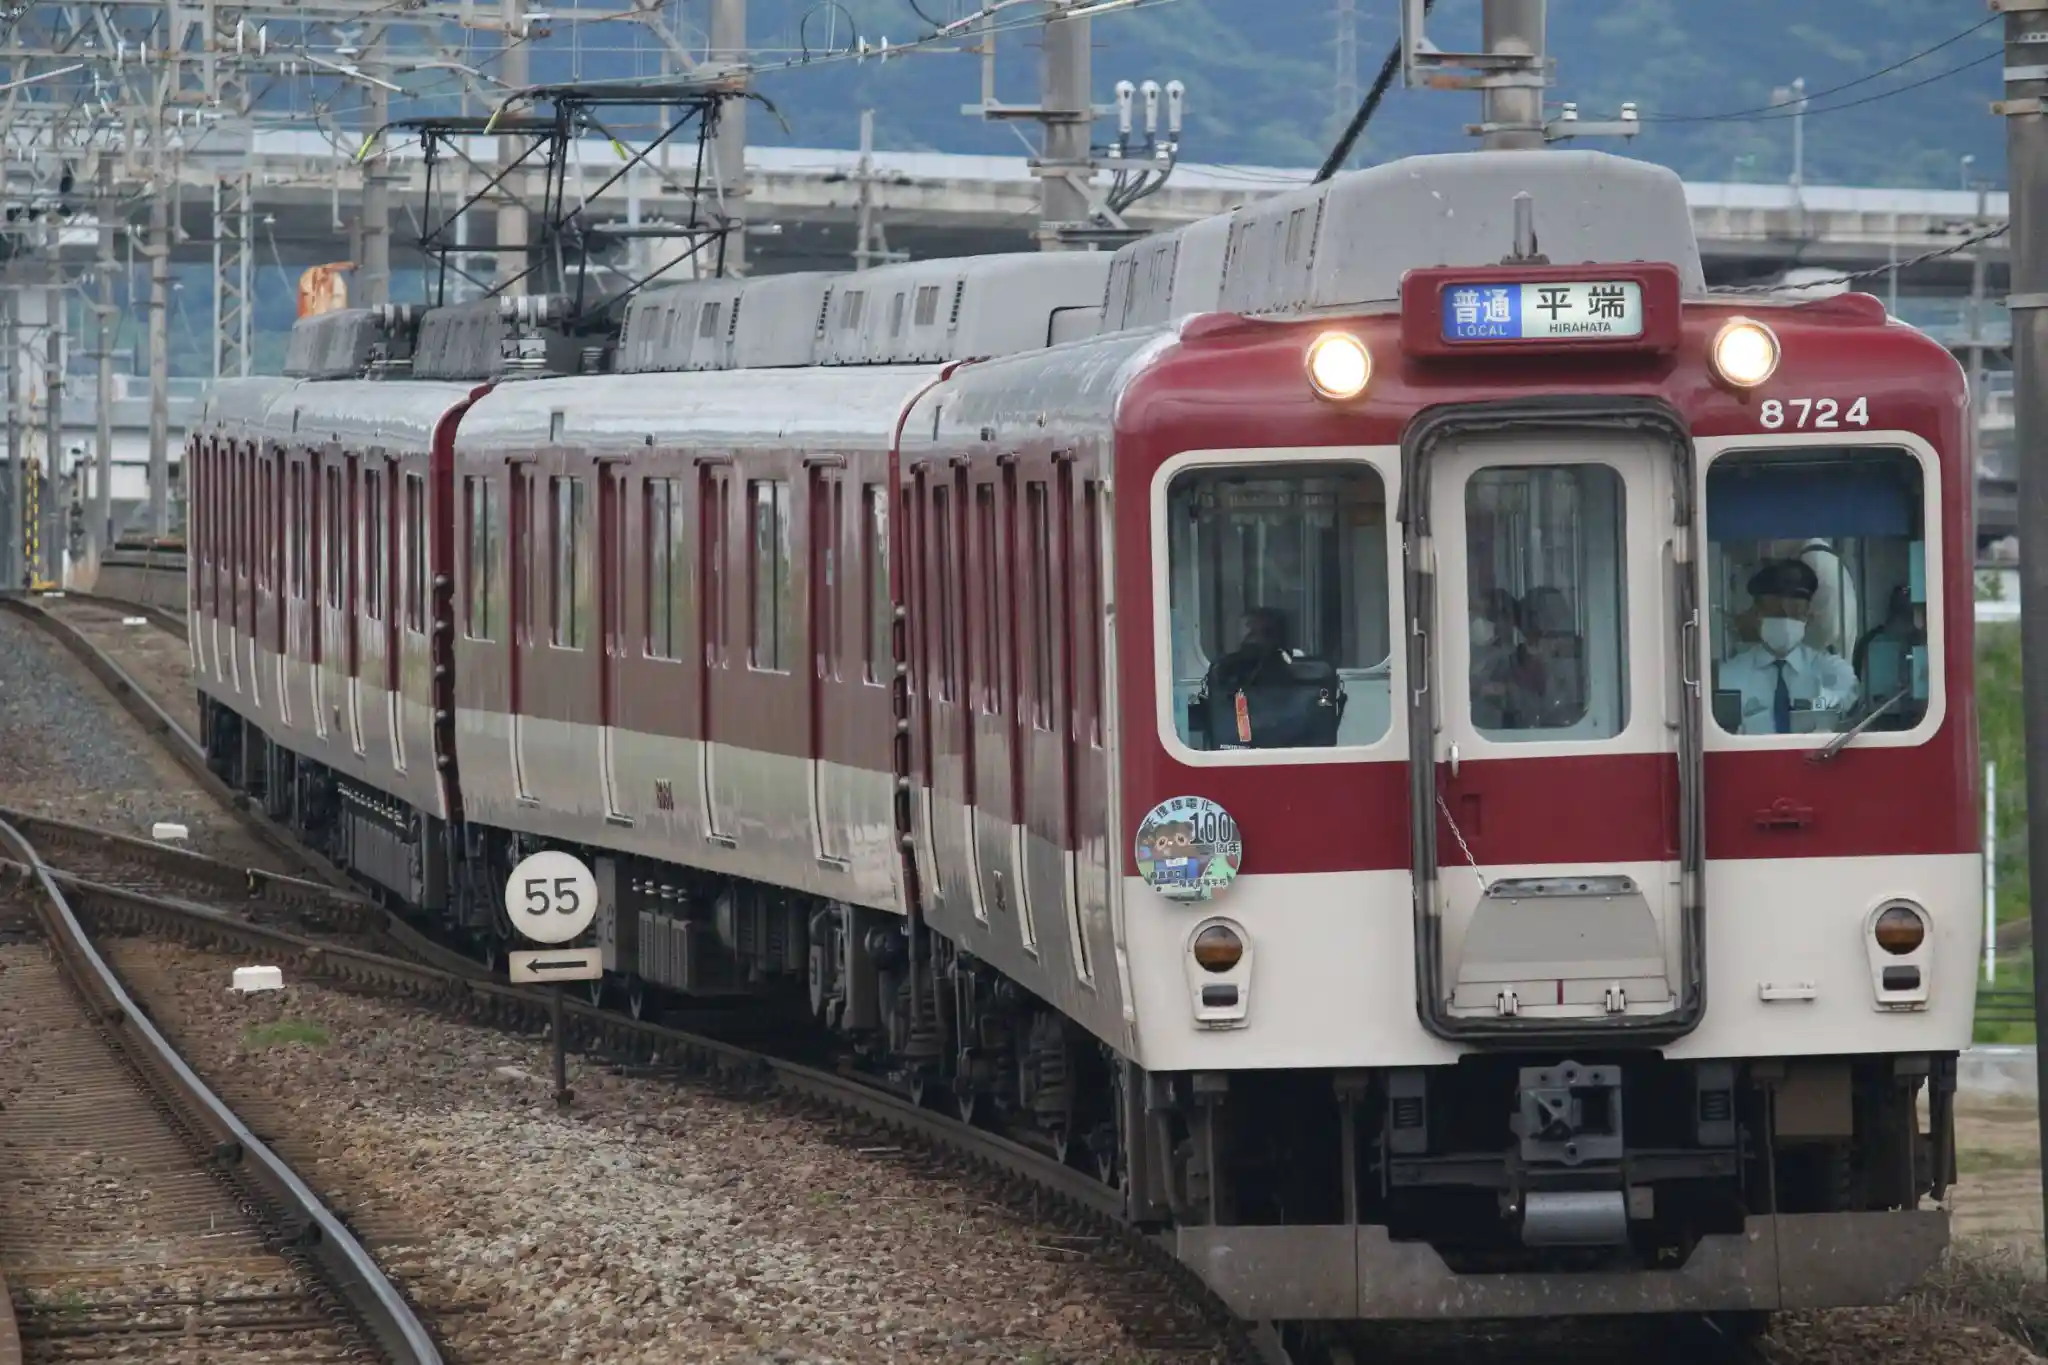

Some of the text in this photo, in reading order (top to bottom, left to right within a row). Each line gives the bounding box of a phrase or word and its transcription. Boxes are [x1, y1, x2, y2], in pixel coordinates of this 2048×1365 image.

[1452, 288, 1511, 324] 普通
[1536, 284, 1626, 321] 平端
[1457, 325, 1507, 337] LOCAL
[1549, 321, 1613, 334] HIRAHATA
[1760, 396, 1870, 429] 8724
[1189, 811, 1232, 845] 100
[525, 877, 580, 916] 55
